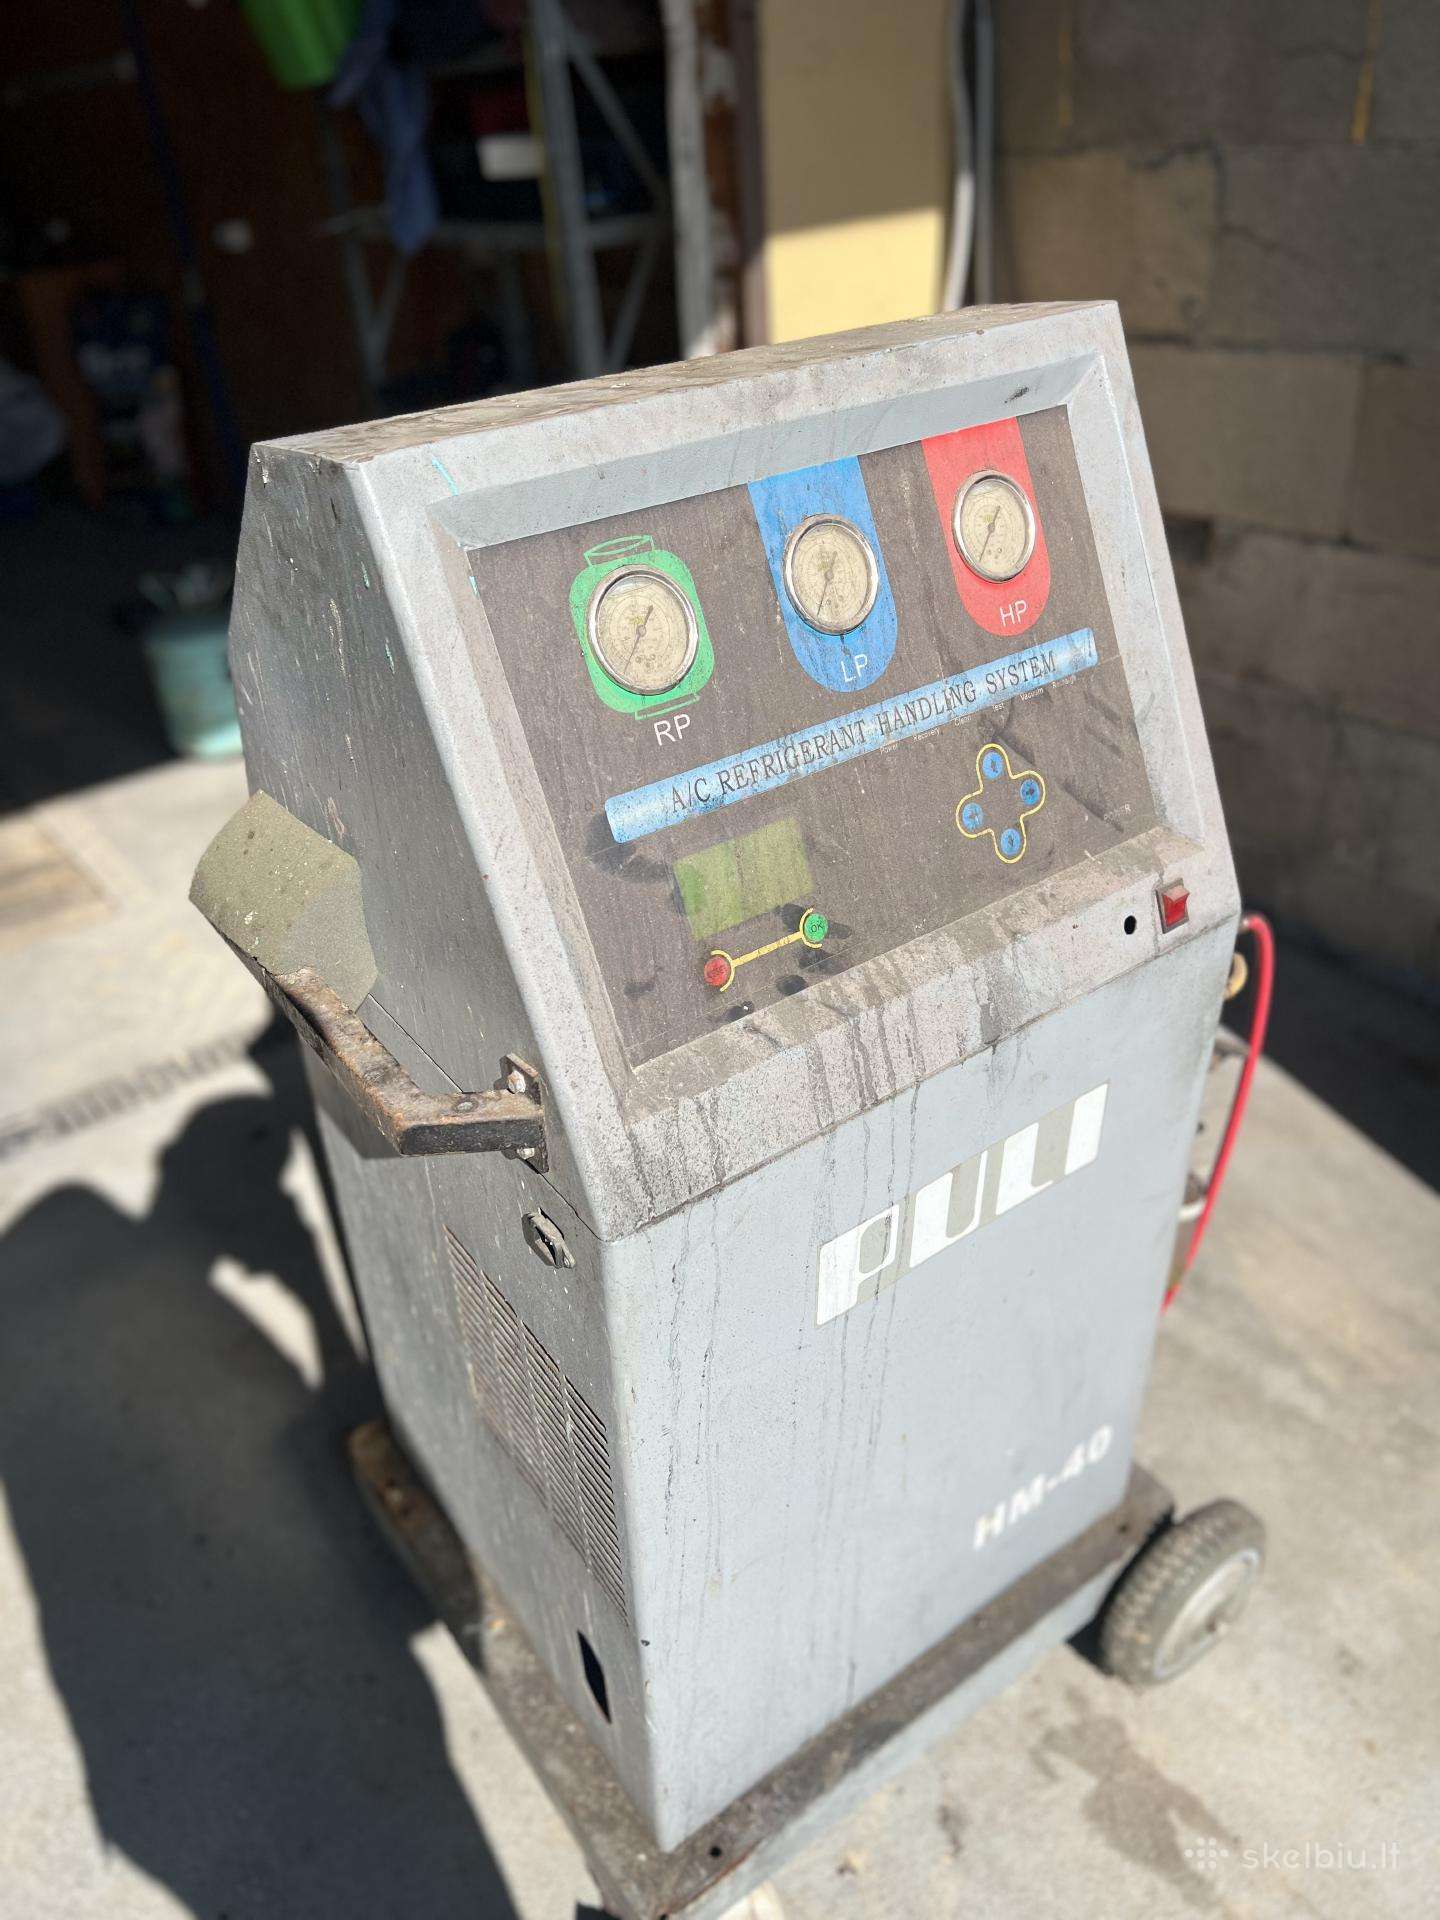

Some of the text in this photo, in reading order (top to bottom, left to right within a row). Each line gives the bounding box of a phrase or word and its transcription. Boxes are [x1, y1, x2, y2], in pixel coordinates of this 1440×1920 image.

[999, 600, 1028, 628] HP
[840, 653, 868, 683] LP
[653, 713, 691, 746] RP
[672, 650, 1057, 813] A/C REFRIGERANT HANDLING SYSTEM
[912, 726, 940, 742] Recovery
[1019, 687, 1044, 701] Vacuum
[973, 1423, 1113, 1551] HM-40
